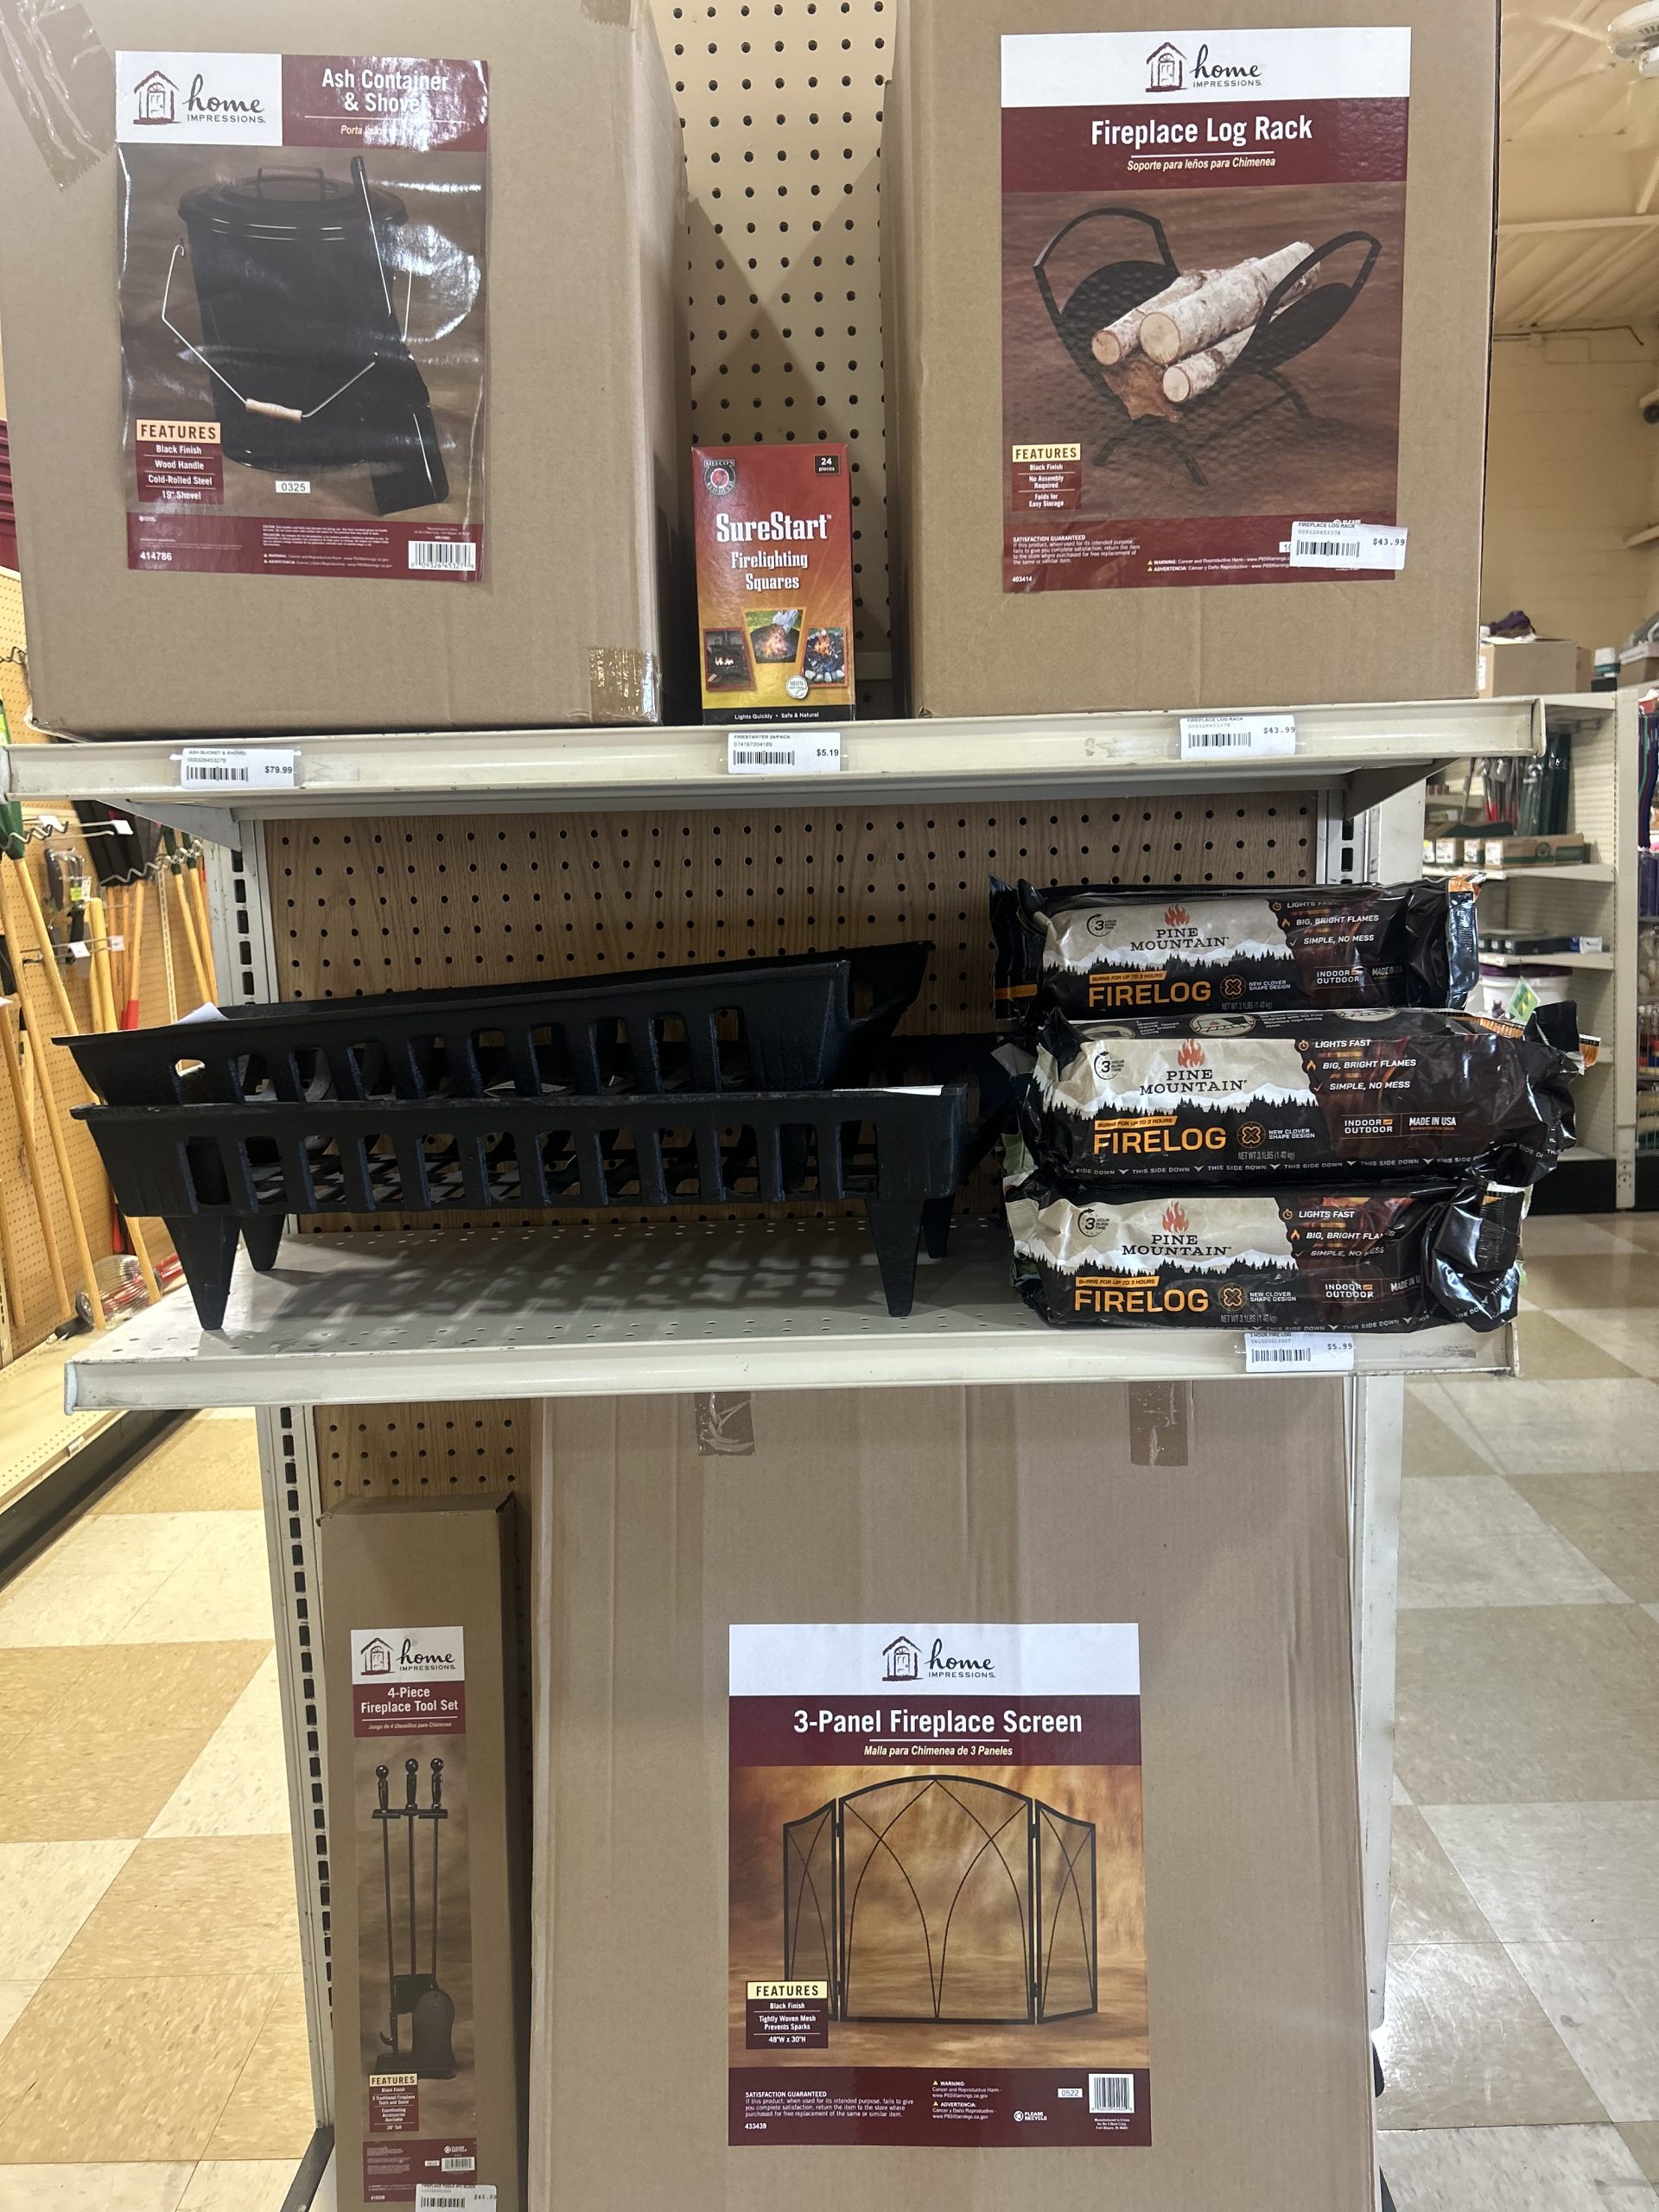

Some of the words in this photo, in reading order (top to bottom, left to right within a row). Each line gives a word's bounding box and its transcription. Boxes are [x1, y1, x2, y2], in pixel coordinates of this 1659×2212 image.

[1189, 43, 1262, 79] home
[321, 68, 354, 87] Ash
[362, 68, 448, 91] Container
[182, 73, 264, 113] home
[344, 92, 359, 111] &
[340, 124, 362, 135] Porta
[1091, 118, 1198, 150] Fireplace
[1206, 117, 1248, 147] Log
[1255, 114, 1313, 140] Rack
[1127, 159, 1161, 172] Soporte
[1163, 160, 1183, 171] para
[1185, 156, 1209, 168] leños
[1210, 158, 1231, 169] para
[1232, 156, 1276, 168] Chimenea
[141, 424, 216, 440] FEATURES
[156, 444, 177, 454] Black
[179, 445, 202, 455] Finish
[1015, 448, 1077, 460] FEATURES
[155, 460, 176, 469] Wood
[178, 461, 204, 470] Handle
[821, 457, 832, 466] 24
[148, 474, 192, 486] Cold-Rolled
[193, 476, 213, 486] Steel
[1038, 474, 1064, 484] Assembly
[281, 482, 307, 493] 0325
[176, 491, 201, 500] Shovel
[1043, 499, 1064, 508] Storage
[140, 551, 172, 561] 414786
[731, 550, 808, 570] Firelighting
[747, 573, 800, 592] Squares
[817, 748, 839, 757] $5.19
[264, 766, 293, 774] $79.99
[1094, 919, 1104, 931] 3
[1296, 918, 1313, 926] BIG,
[1314, 916, 1345, 925] BRIGHT
[1347, 914, 1379, 923] FLAMES
[1156, 927, 1198, 939] PINE
[1130, 937, 1227, 951] MOUNTAIN
[1303, 936, 1336, 945] SIMPLE,
[1338, 935, 1351, 944] NO
[1352, 934, 1375, 943] MESS
[1317, 969, 1351, 978] INDOOR
[1317, 976, 1359, 985] OUTDOOR
[1089, 982, 1211, 1007] FIRELOG
[1314, 1040, 1348, 1049] LIGHTS
[1101, 1060, 1111, 1073] 3
[1322, 1061, 1341, 1071] BIG,
[1344, 1059, 1379, 1069] BRIGHT
[1381, 1058, 1417, 1068] FLAMES
[1166, 1069, 1213, 1081] PINE
[1140, 1080, 1244, 1096] MOUNTAIN
[1330, 1082, 1366, 1091] SIMPLE,
[1368, 1081, 1382, 1090] NO
[1384, 1080, 1411, 1090] MESS
[1344, 1118, 1382, 1127] INDOOR
[1409, 1116, 1430, 1127] MADE
[1431, 1116, 1440, 1126] IN
[1442, 1116, 1457, 1126] USA
[1344, 1125, 1393, 1134] OUTDOOR
[1093, 1127, 1226, 1155] FIRELOG
[1084, 1217, 1096, 1230] 3
[1152, 1234, 1198, 1245] PINE
[1306, 1231, 1324, 1241] BIG,
[1326, 1231, 1361, 1240] BRIGHT
[1122, 1244, 1228, 1256] MOUNTAIN
[1390, 1280, 1408, 1292] MADE
[1074, 1288, 1209, 1313] FIRELOG
[396, 1638, 455, 1664] home
[925, 1638, 995, 1670] home
[387, 1687, 430, 1699] 4-Piece
[361, 1701, 411, 1715] Fireplace
[414, 1700, 437, 1712] Tool
[441, 1699, 459, 1711] Set
[793, 1709, 882, 1733] 3-Panel
[890, 1708, 995, 1738] Fireplace
[1002, 1709, 1083, 1733] Screen
[864, 1745, 887, 1756] Malla
[889, 1747, 909, 1758] para
[911, 1745, 956, 1757] Chimenea
[957, 1745, 969, 1756] de
[970, 1745, 976, 1756] 3
[978, 1745, 1014, 1757] Paneles
[756, 1985, 819, 1997] FEATURES
[759, 2015, 779, 2024] Tightly
[372, 2075, 415, 2085] FEATURES
